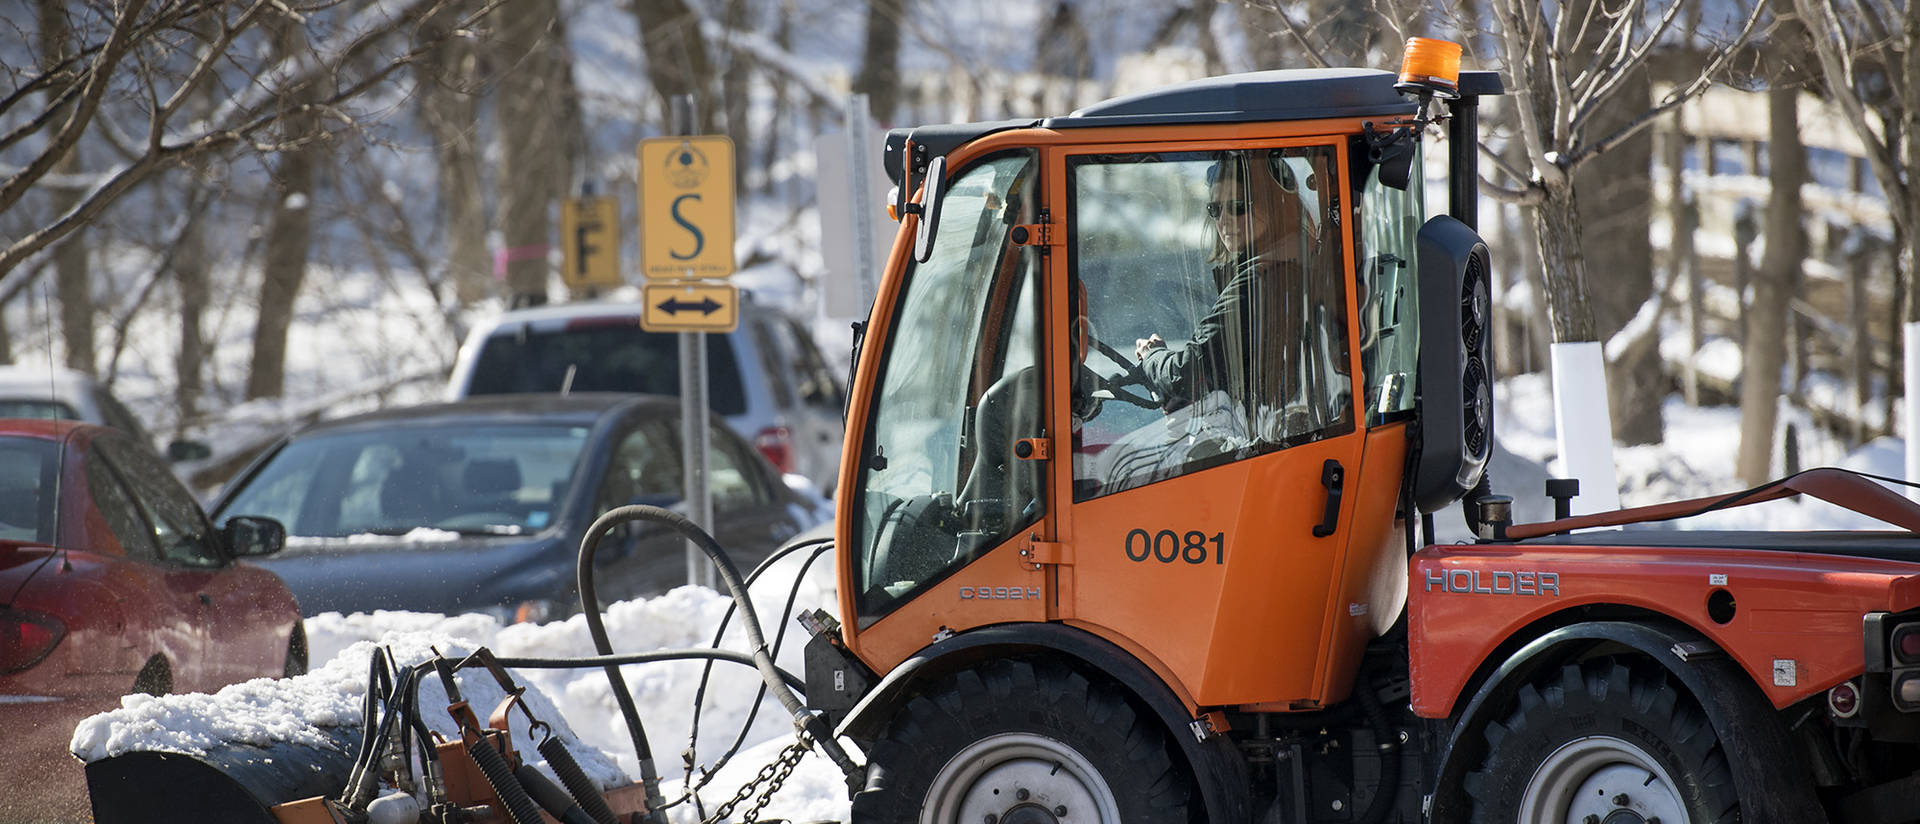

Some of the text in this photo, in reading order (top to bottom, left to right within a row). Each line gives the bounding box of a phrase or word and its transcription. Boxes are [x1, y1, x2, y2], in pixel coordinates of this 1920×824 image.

[576, 222, 604, 276] F
[669, 193, 705, 260] S
[1125, 528, 1225, 565] 0081
[1425, 568, 1560, 597] HOLDER
